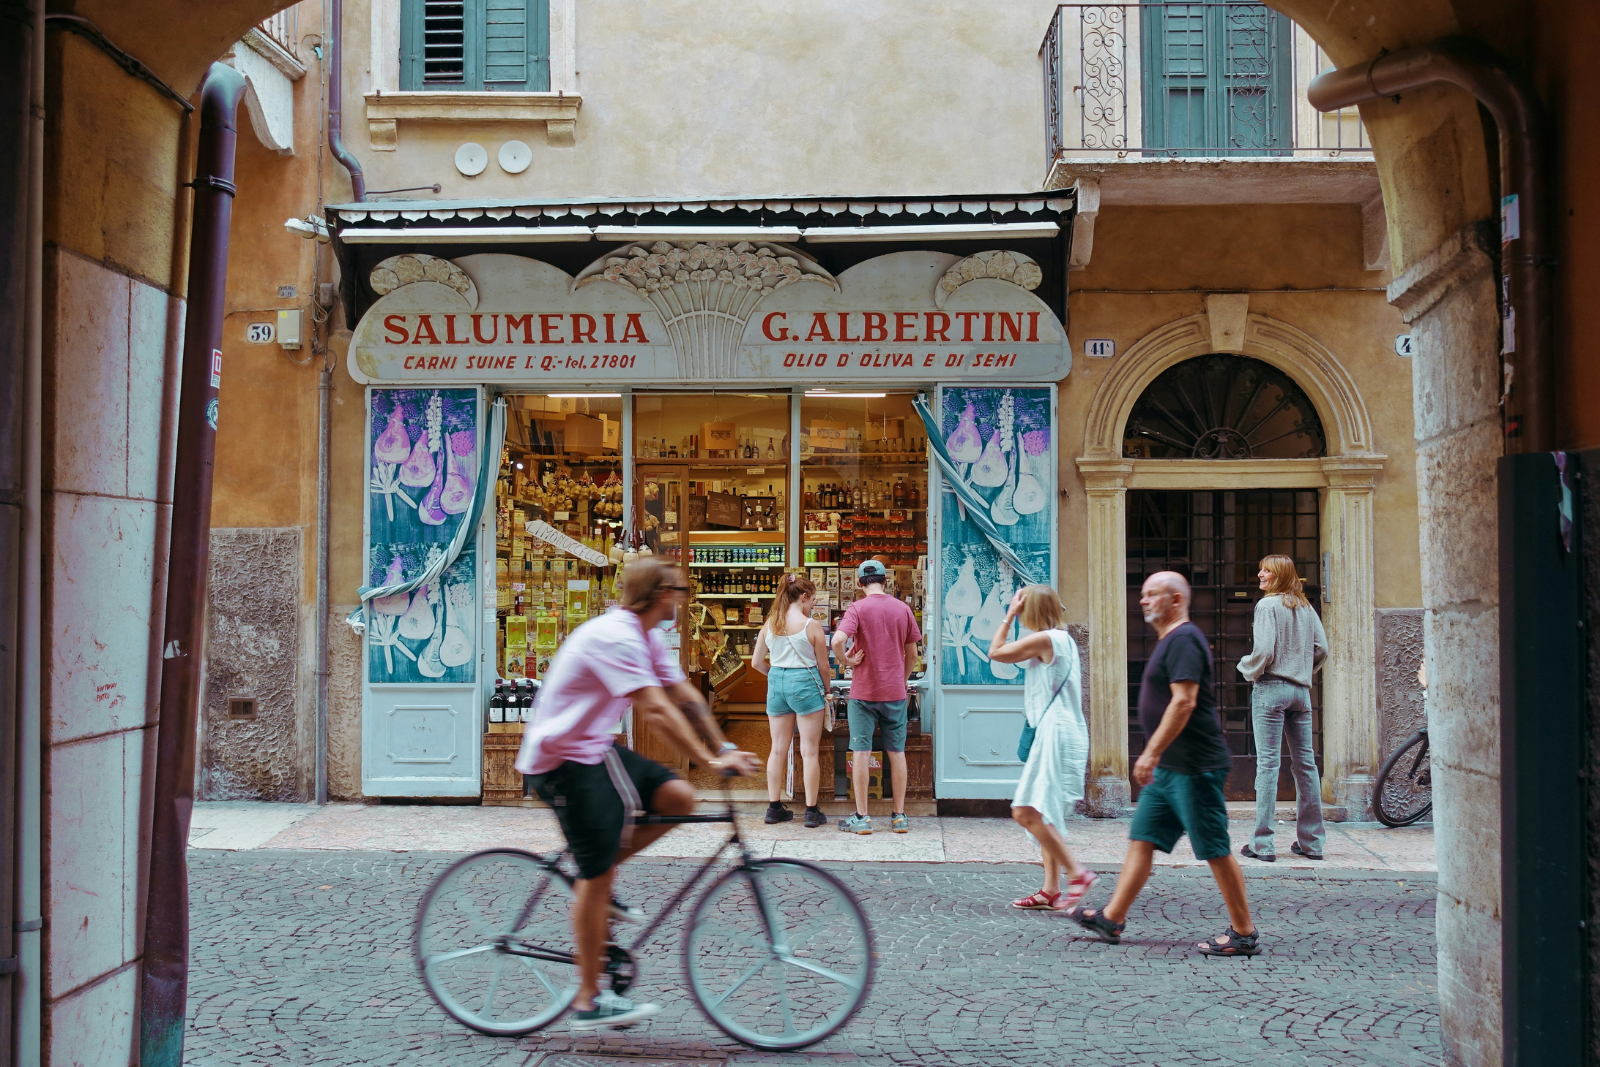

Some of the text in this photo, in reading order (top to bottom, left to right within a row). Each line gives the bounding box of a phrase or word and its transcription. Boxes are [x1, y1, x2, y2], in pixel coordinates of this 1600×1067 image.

[251, 325, 272, 341] 39
[383, 312, 650, 345] SALUMERIA
[1400, 337, 1412, 353] 4
[404, 355, 458, 370] CARNI
[466, 355, 517, 369] SUINE
[783, 353, 828, 367] OLIO
[923, 353, 936, 367] E
[944, 353, 964, 367] DI
[972, 353, 1017, 367] SEMI
